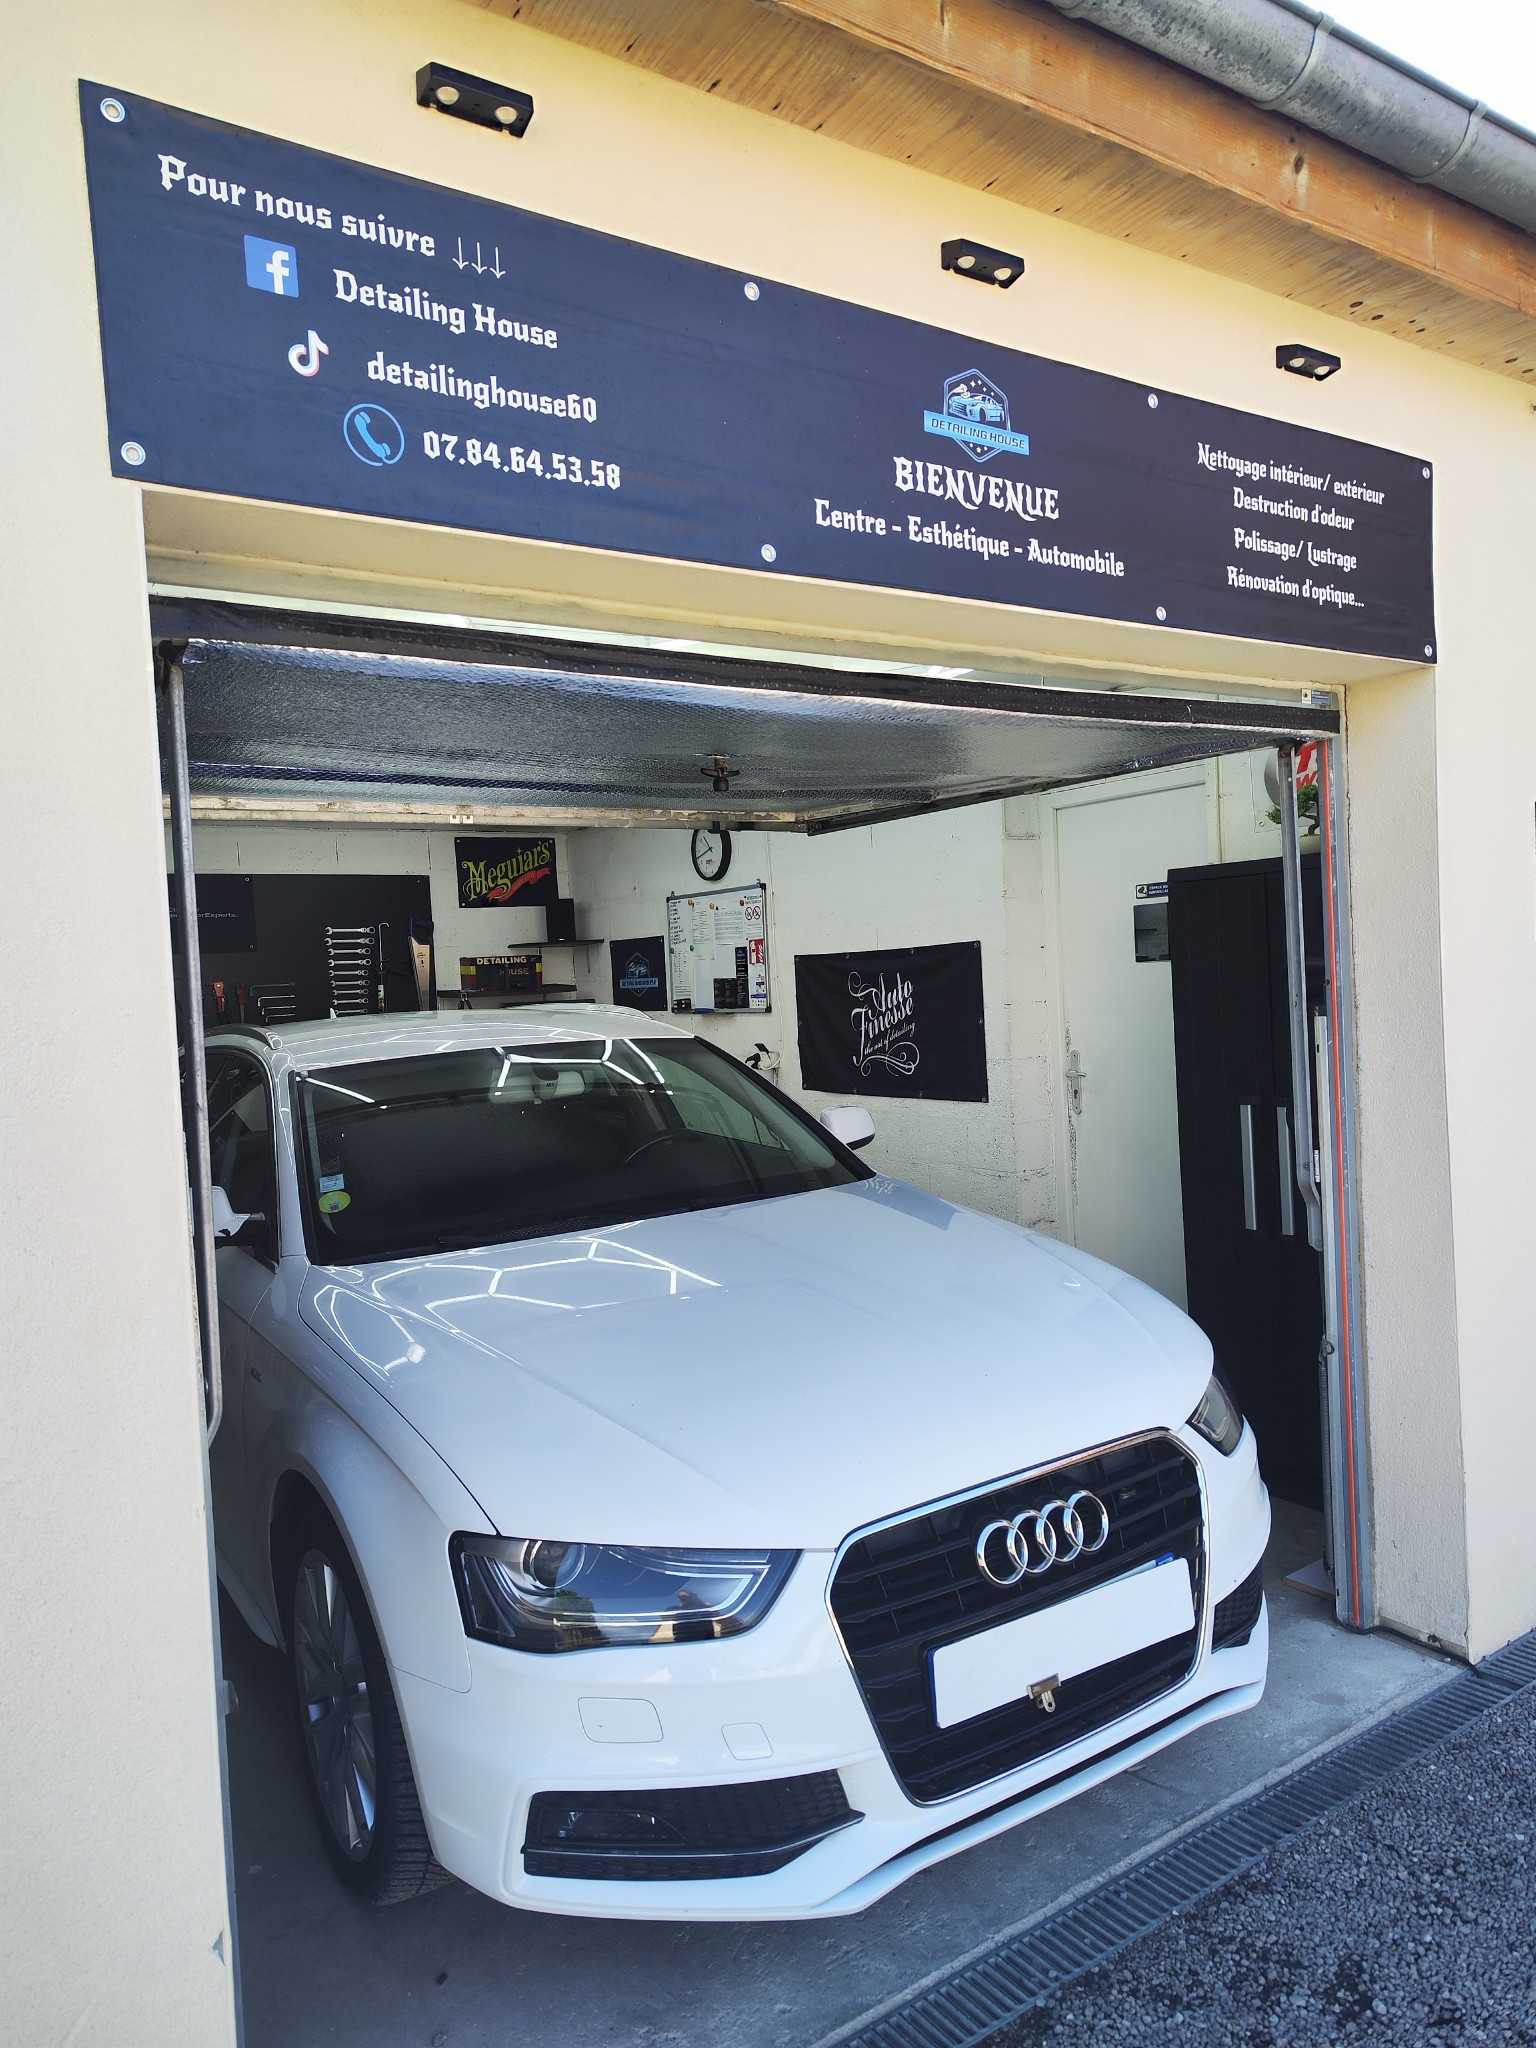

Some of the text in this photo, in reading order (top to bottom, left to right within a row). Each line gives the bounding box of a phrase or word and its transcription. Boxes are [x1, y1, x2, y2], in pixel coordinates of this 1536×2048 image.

[157, 153, 436, 257] Pour nous suivre
[333, 269, 558, 349] Detailing House
[367, 351, 598, 424] detailinghouse60
[423, 430, 621, 490] 07.84.64.53.58
[931, 418, 1025, 449] DETAILING HOUSE
[893, 456, 1060, 522] BIENVENUE
[1198, 442, 1385, 505] Nettoyage intérieur/ extérieur
[814, 498, 886, 536] Centre
[908, 515, 1010, 561] Esthétique
[1027, 538, 1125, 577] Automobile
[1233, 487, 1355, 531] Destruction d'odeur
[1234, 528, 1357, 573] Polissage/ Lustrage
[1227, 565, 1300, 598] Rénovation
[476, 956, 527, 965] DETAILING
